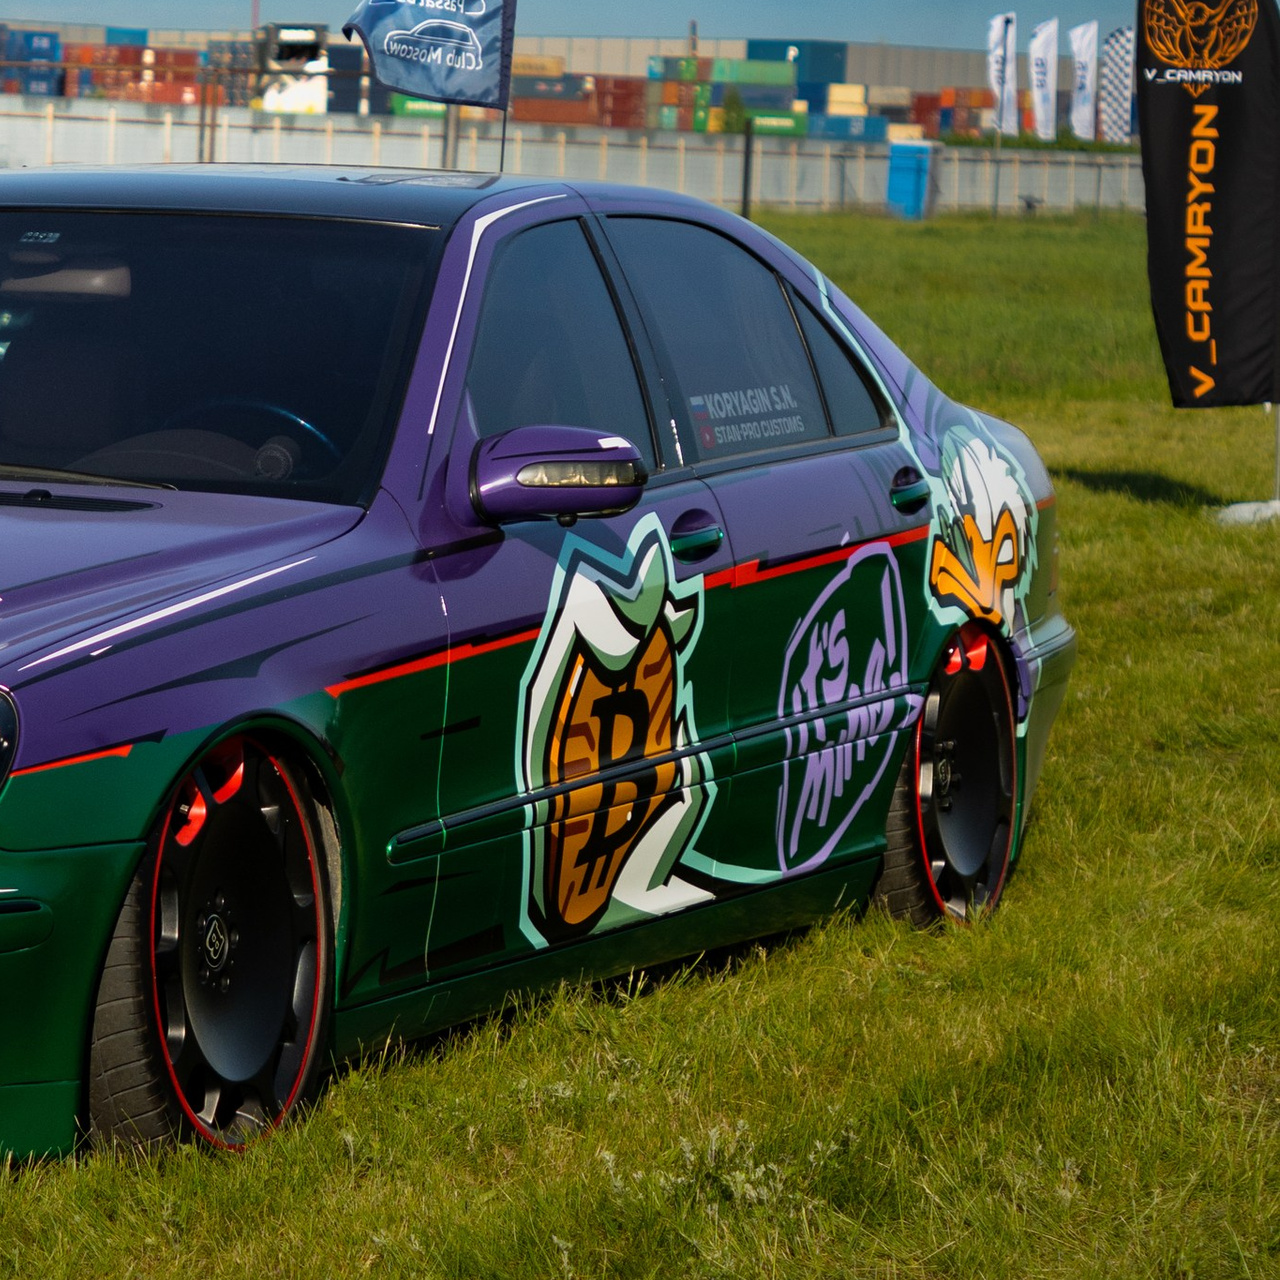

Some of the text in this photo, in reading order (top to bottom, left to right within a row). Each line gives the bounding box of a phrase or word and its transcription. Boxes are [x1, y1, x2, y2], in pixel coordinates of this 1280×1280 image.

[1144, 68, 1243, 84] V_CAMRYON
[1185, 104, 1220, 399] V_CAMRYON
[704, 384, 798, 419] KORYAGIN S.N.
[760, 415, 805, 438] CUSTOMS
